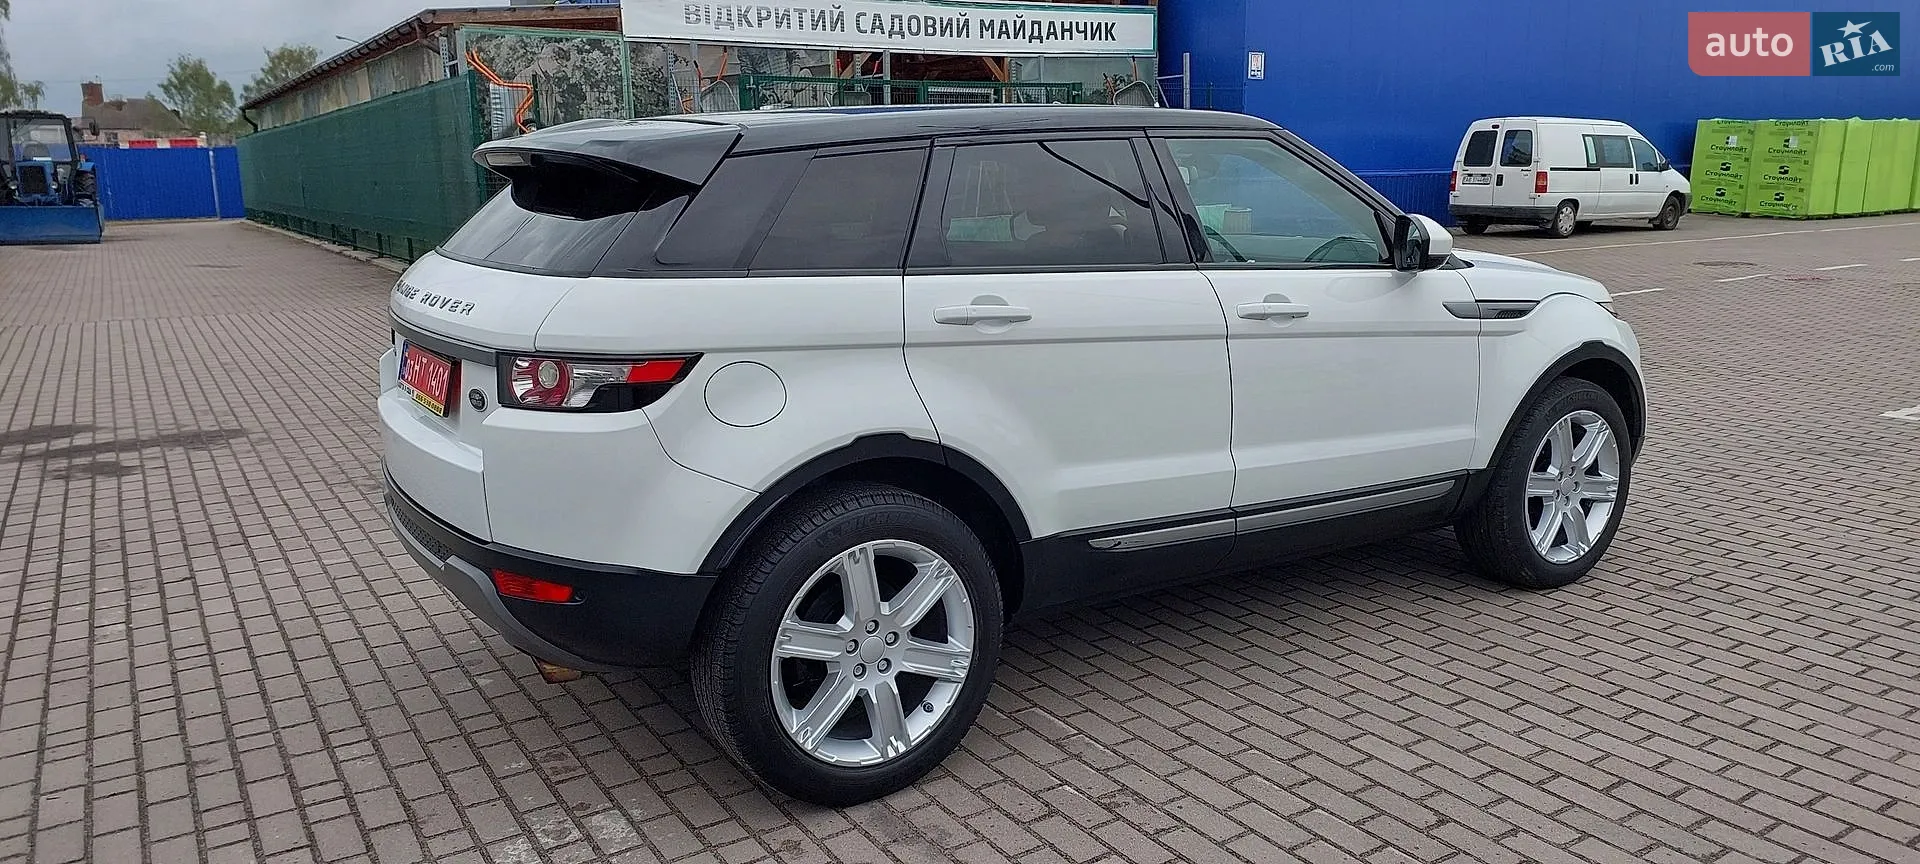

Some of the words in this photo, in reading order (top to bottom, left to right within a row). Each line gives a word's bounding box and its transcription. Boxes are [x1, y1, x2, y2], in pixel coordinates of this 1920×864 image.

[684, 3, 845, 33] ВІДКРИТИЙ
[856, 11, 970, 40] САДОВИЙ
[979, 14, 1117, 44] МАЙДАНЧИК
[1710, 144, 1749, 153] Стоунлайт
[1767, 146, 1808, 156] Стоунлайт
[1705, 169, 1743, 180] Стоунлайт
[1763, 174, 1803, 183] Стоунлайт
[419, 291, 476, 316] ROVER
[426, 361, 449, 402] 1401
